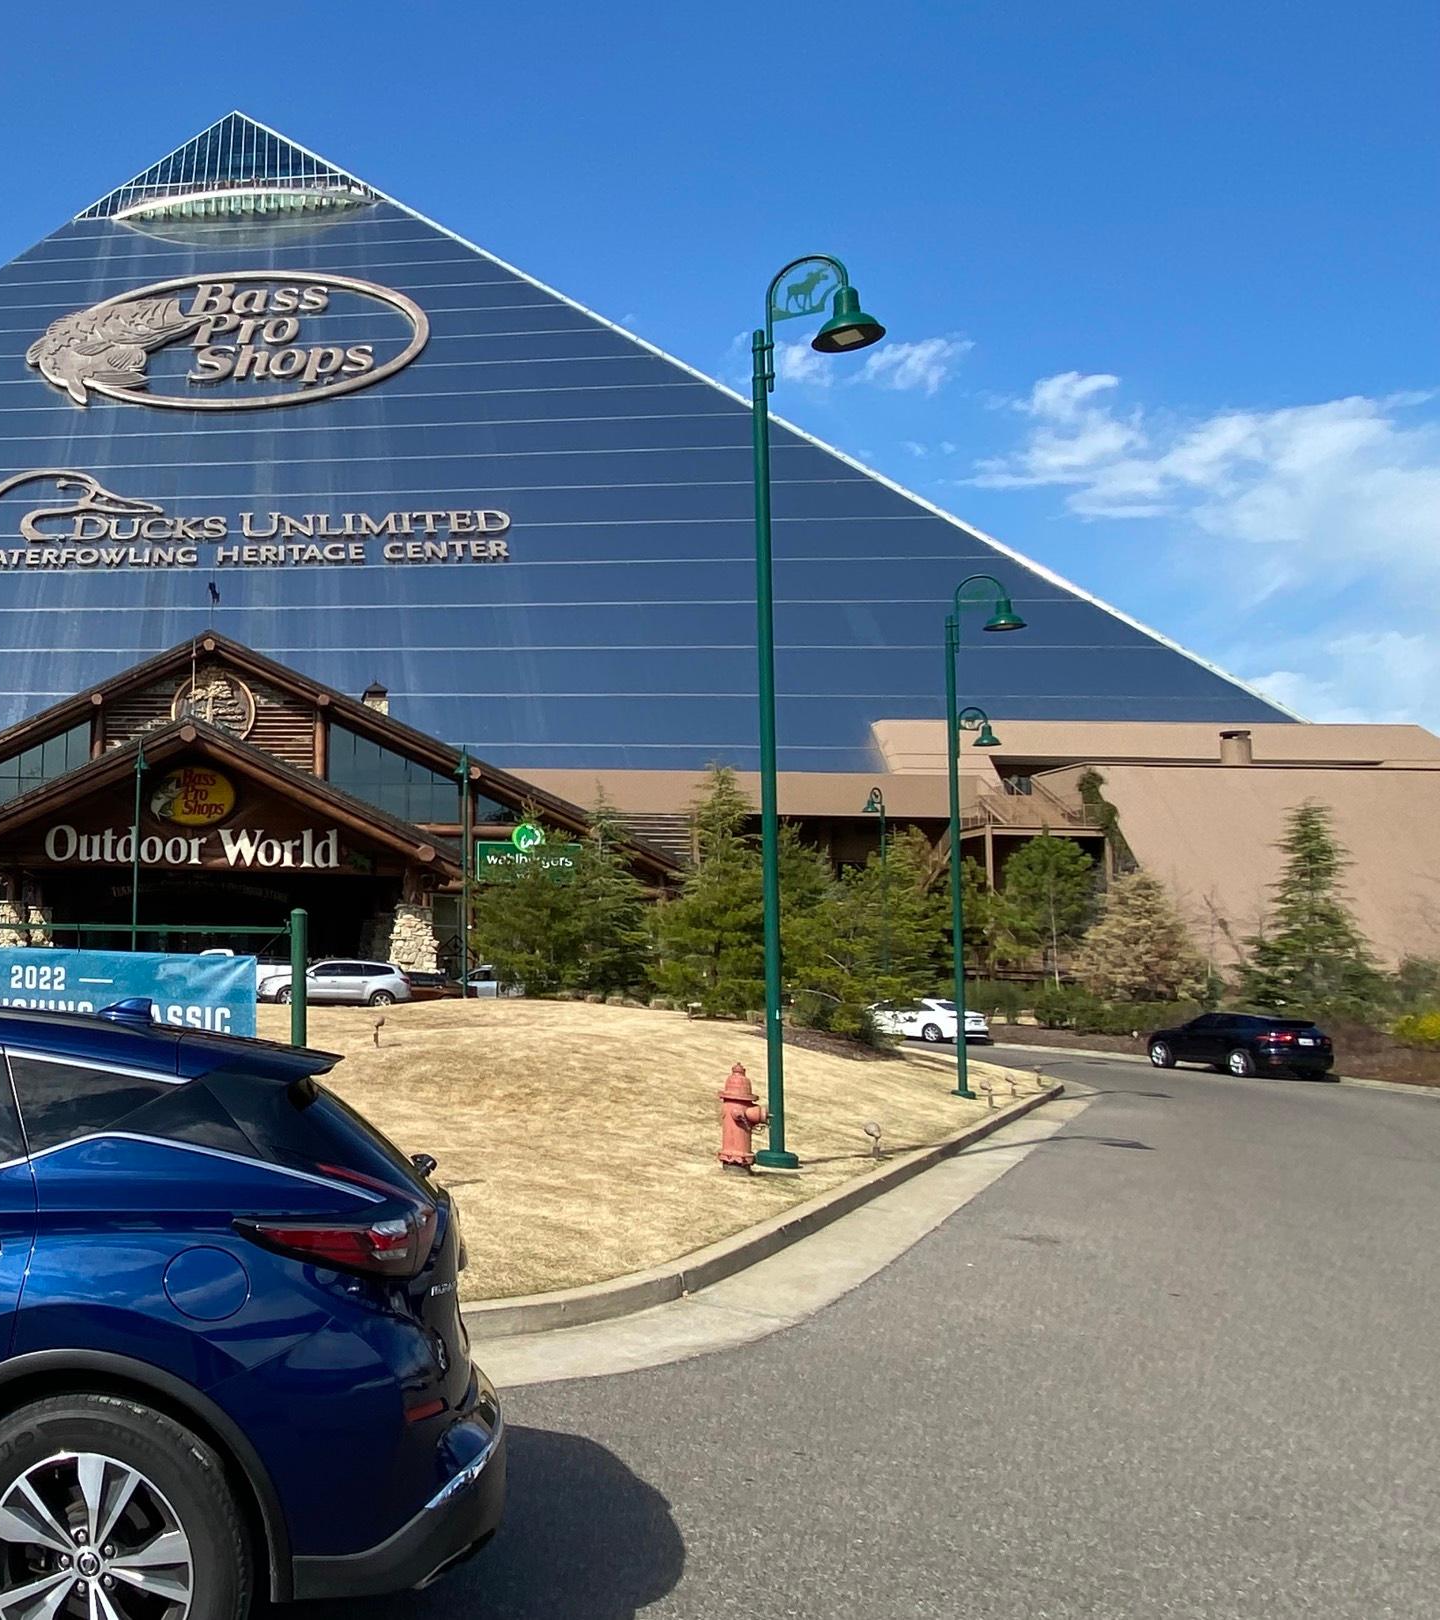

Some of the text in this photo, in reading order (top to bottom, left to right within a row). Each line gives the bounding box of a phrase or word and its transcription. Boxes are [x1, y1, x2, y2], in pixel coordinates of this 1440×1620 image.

[187, 283, 330, 317] Bass
[190, 314, 301, 347] Pro
[188, 344, 376, 385] Shops
[70, 510, 511, 541] DUCKS UNLIMITED
[216, 542, 367, 564] HERITAGE
[383, 539, 511, 561] CENTER
[181, 768, 217, 787] Bass
[181, 785, 209, 801] Pro
[181, 799, 226, 819] Shops
[44, 824, 342, 869] Outdoor World
[9, 964, 66, 991] 2022
